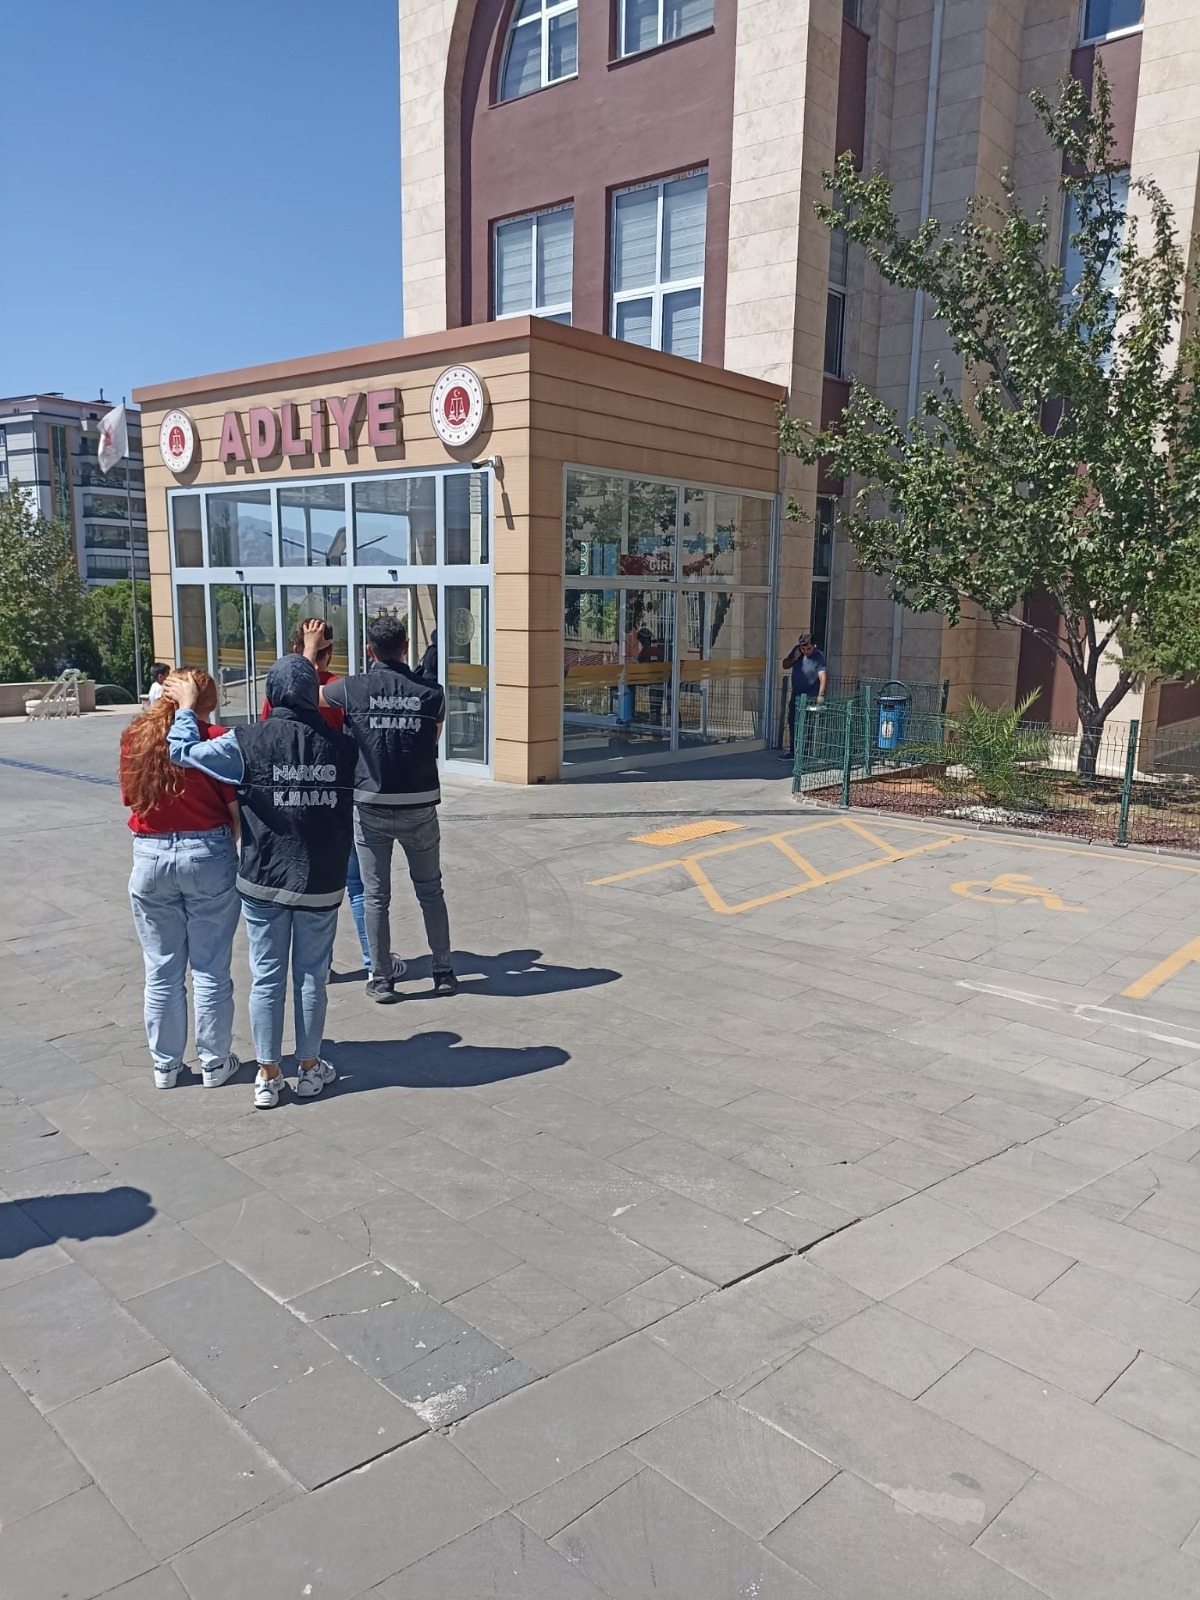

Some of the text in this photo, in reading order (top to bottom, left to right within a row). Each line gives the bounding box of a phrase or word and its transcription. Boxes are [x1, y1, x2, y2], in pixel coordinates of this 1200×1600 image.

[218, 387, 401, 463] ADLİYE
[369, 695, 421, 711] NARKO
[272, 764, 336, 782] NARKO
[273, 791, 337, 808] K.MARAŞ
